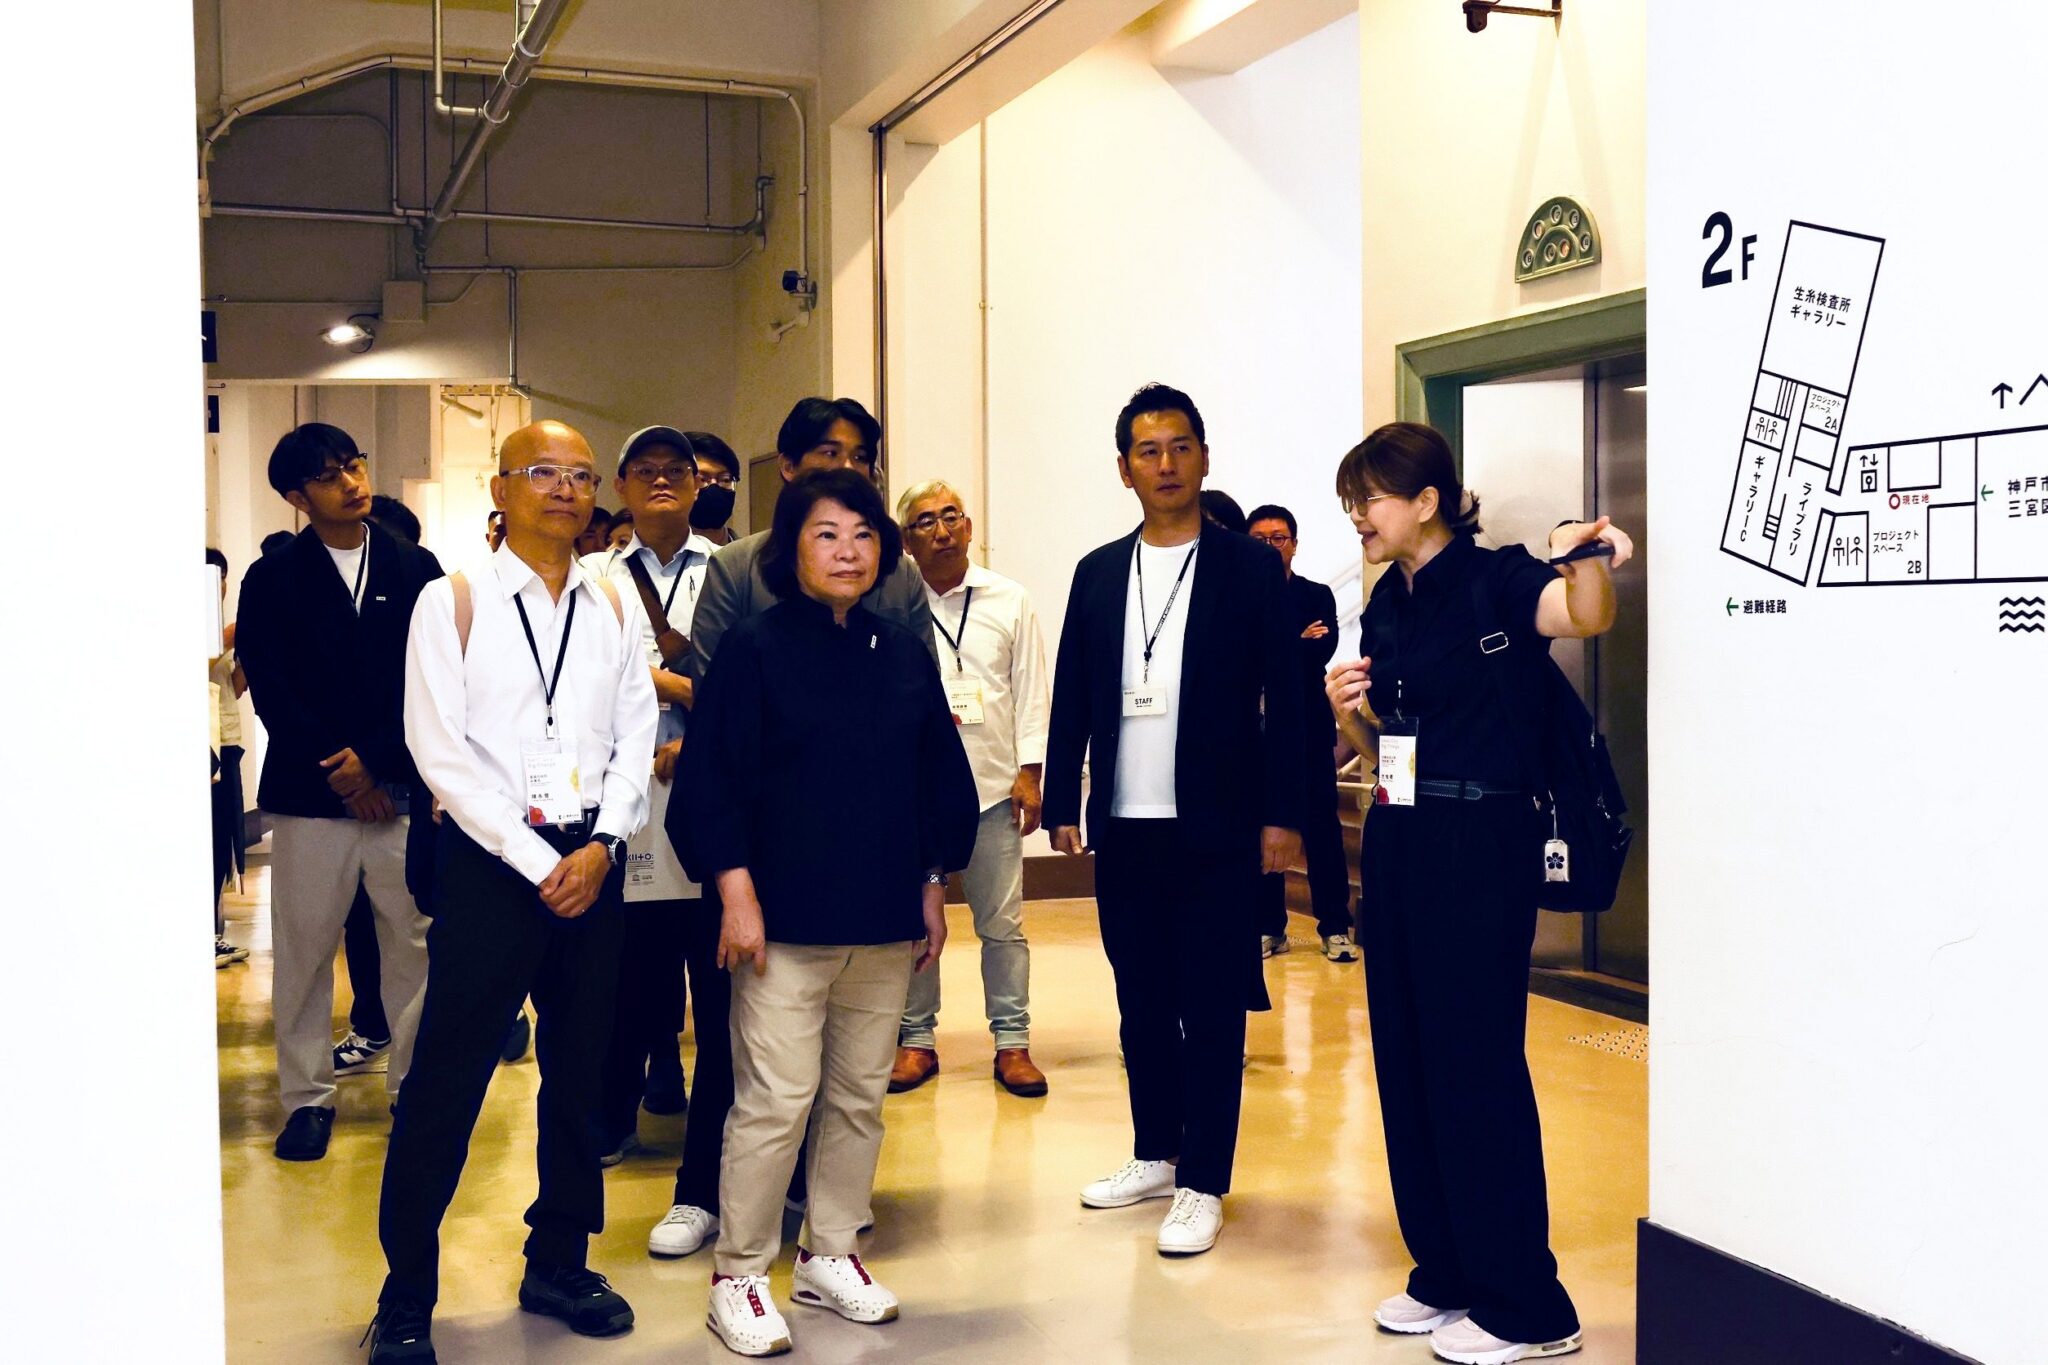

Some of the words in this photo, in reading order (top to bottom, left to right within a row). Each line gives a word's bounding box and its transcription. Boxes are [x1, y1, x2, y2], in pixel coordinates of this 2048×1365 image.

[1793, 286, 1851, 313] 生糸検査所
[1790, 304, 1846, 327] ギャラリー
[1825, 416, 1838, 430] 2A
[1902, 494, 1930, 505] 現在地
[1790, 482, 1812, 556] ライブラリ
[1873, 530, 1919, 541] プロジェクト
[1873, 543, 1904, 554] スペース
[1907, 560, 1922, 574] 2B
[1743, 600, 1787, 614] 避難経路
[1135, 697, 1153, 705] STAFF
